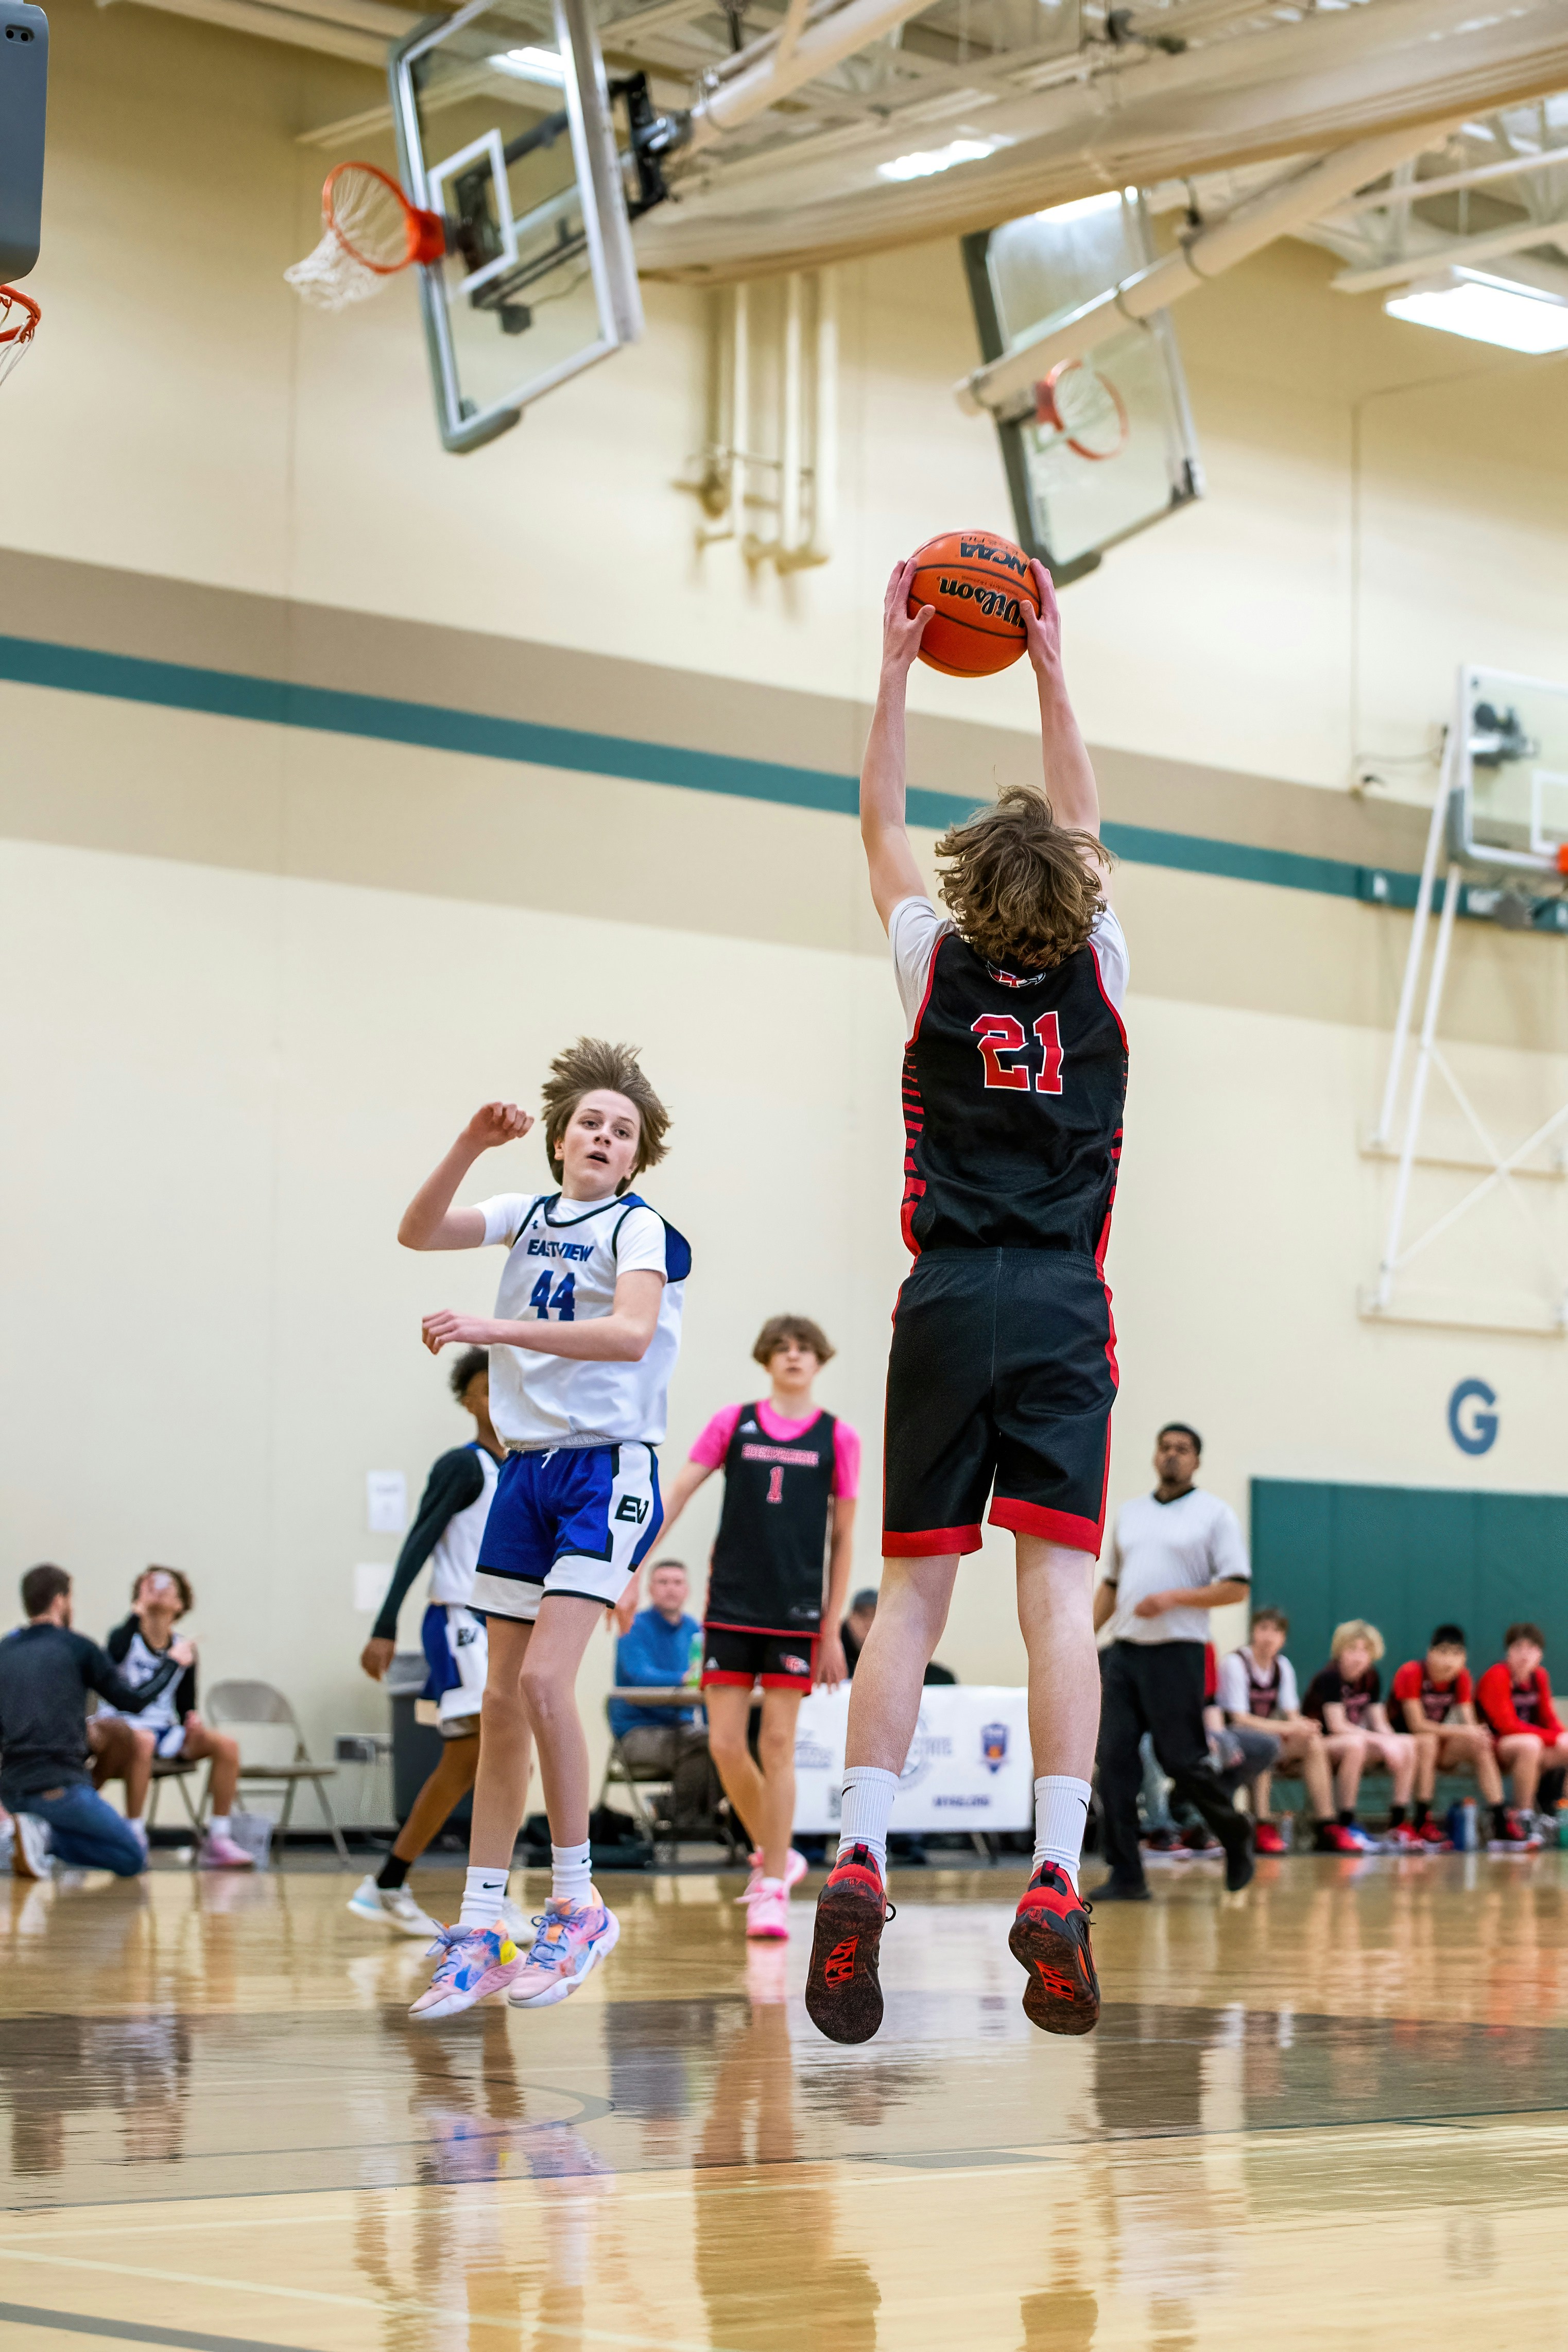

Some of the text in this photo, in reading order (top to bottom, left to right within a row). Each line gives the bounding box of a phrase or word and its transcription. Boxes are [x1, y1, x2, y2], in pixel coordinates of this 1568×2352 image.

[960, 542, 1028, 577] NCAA
[971, 1011, 1063, 1094] 21
[529, 1269, 575, 1321] 44
[1448, 1378, 1498, 1456] G
[766, 1466, 784, 1504] 1
[614, 1494, 649, 1524] EV
